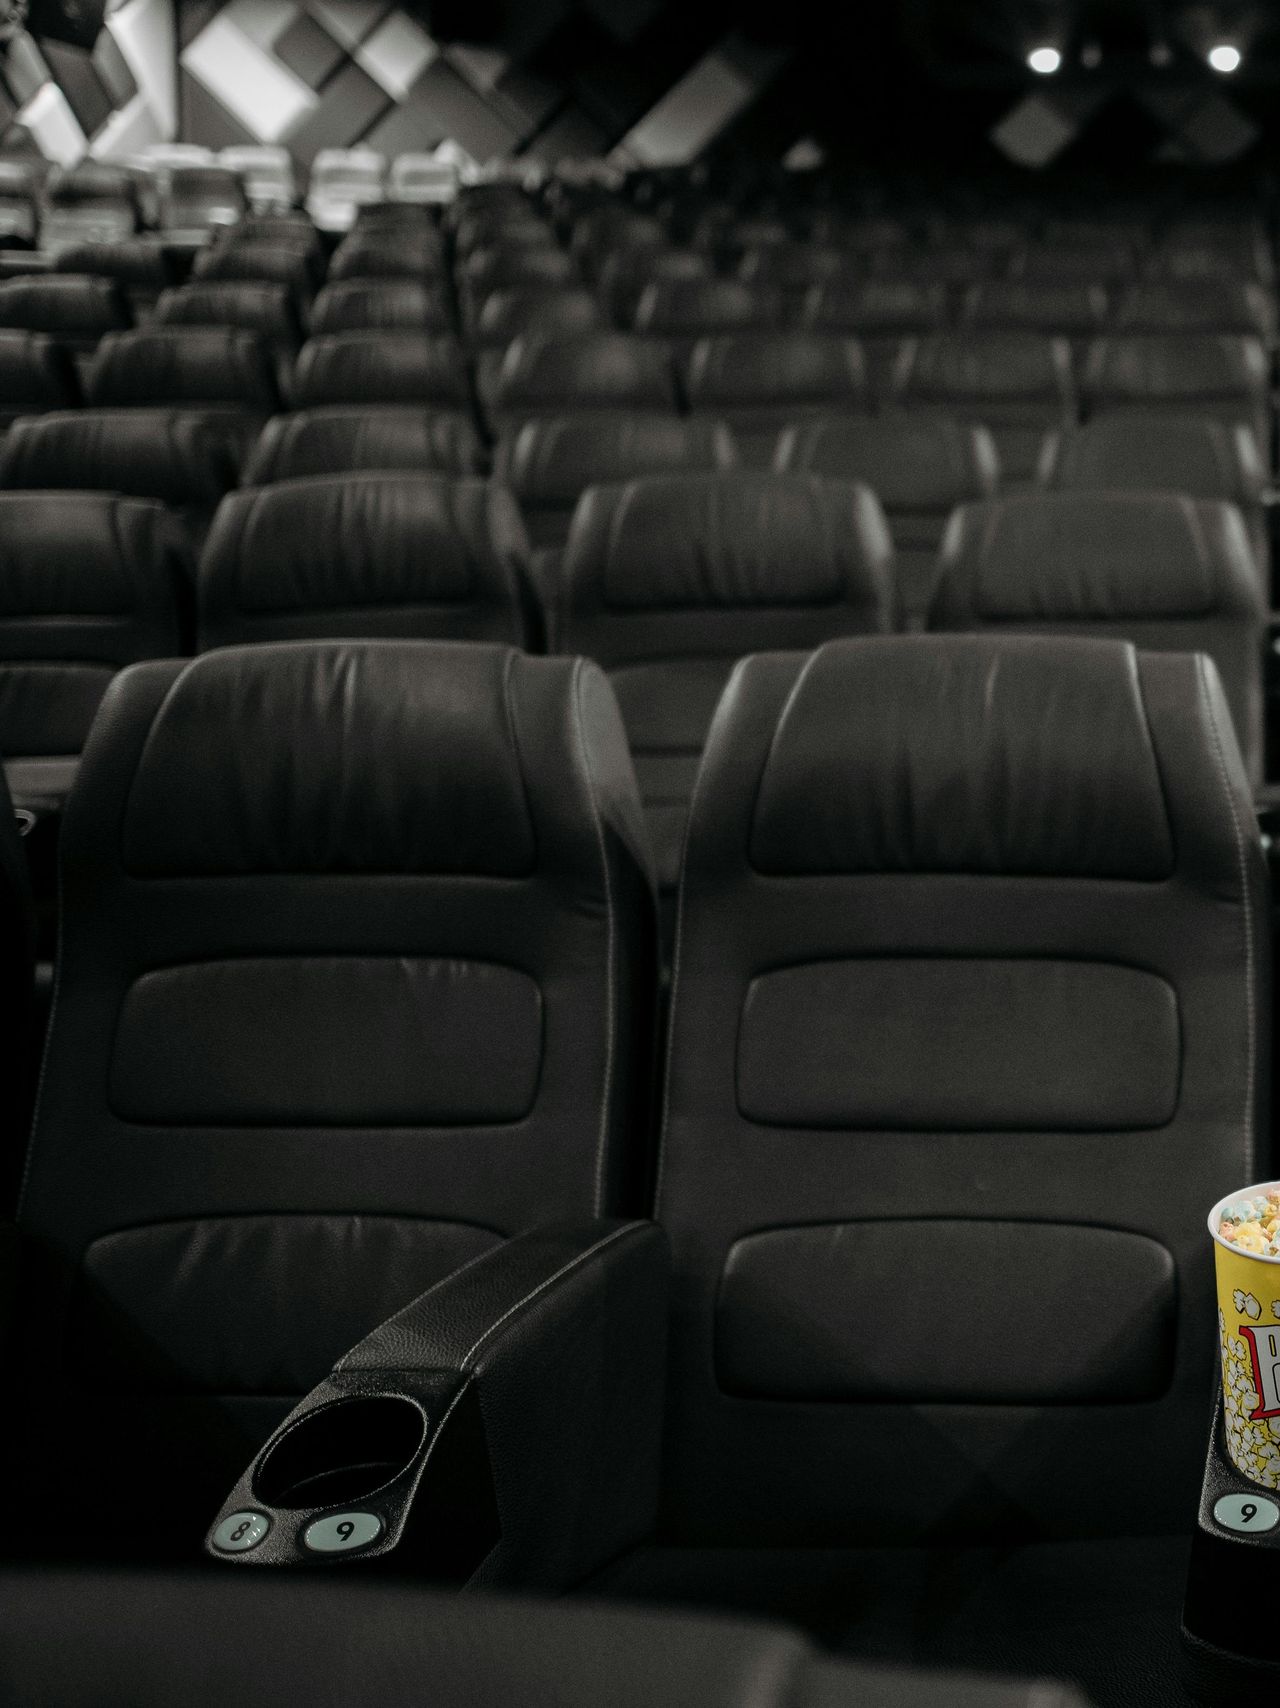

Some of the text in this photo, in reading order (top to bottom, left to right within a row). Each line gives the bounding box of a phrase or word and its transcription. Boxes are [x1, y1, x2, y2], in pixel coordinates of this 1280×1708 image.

[1240, 1503, 1258, 1523] 9
[230, 1520, 251, 1542] 8
[336, 1521, 355, 1542] 9
